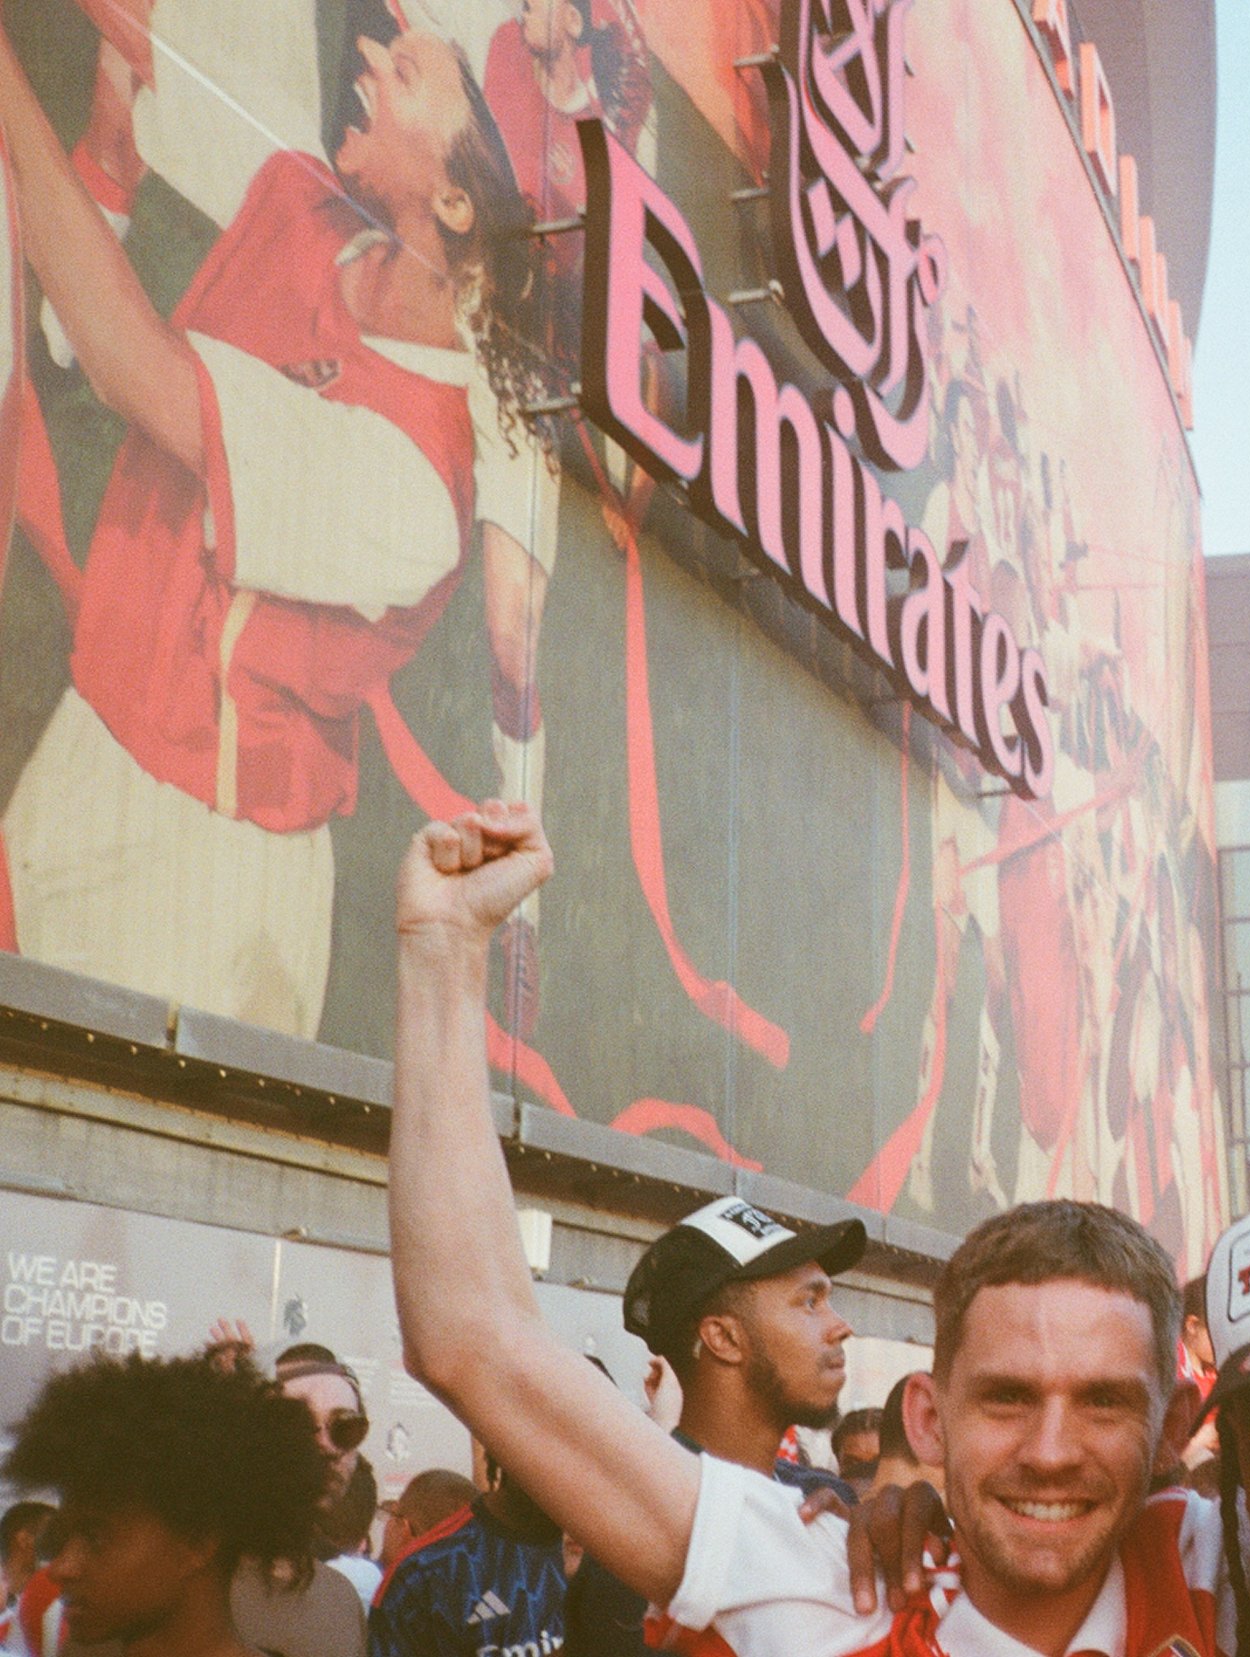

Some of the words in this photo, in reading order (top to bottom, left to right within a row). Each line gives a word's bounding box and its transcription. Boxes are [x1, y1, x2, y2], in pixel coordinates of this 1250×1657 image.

[592, 120, 1055, 798] Emirates
[8, 1252, 57, 1286] WE
[59, 1260, 118, 1294] ARE
[2, 1314, 44, 1346] OF
[46, 1319, 158, 1358] EUROPE
